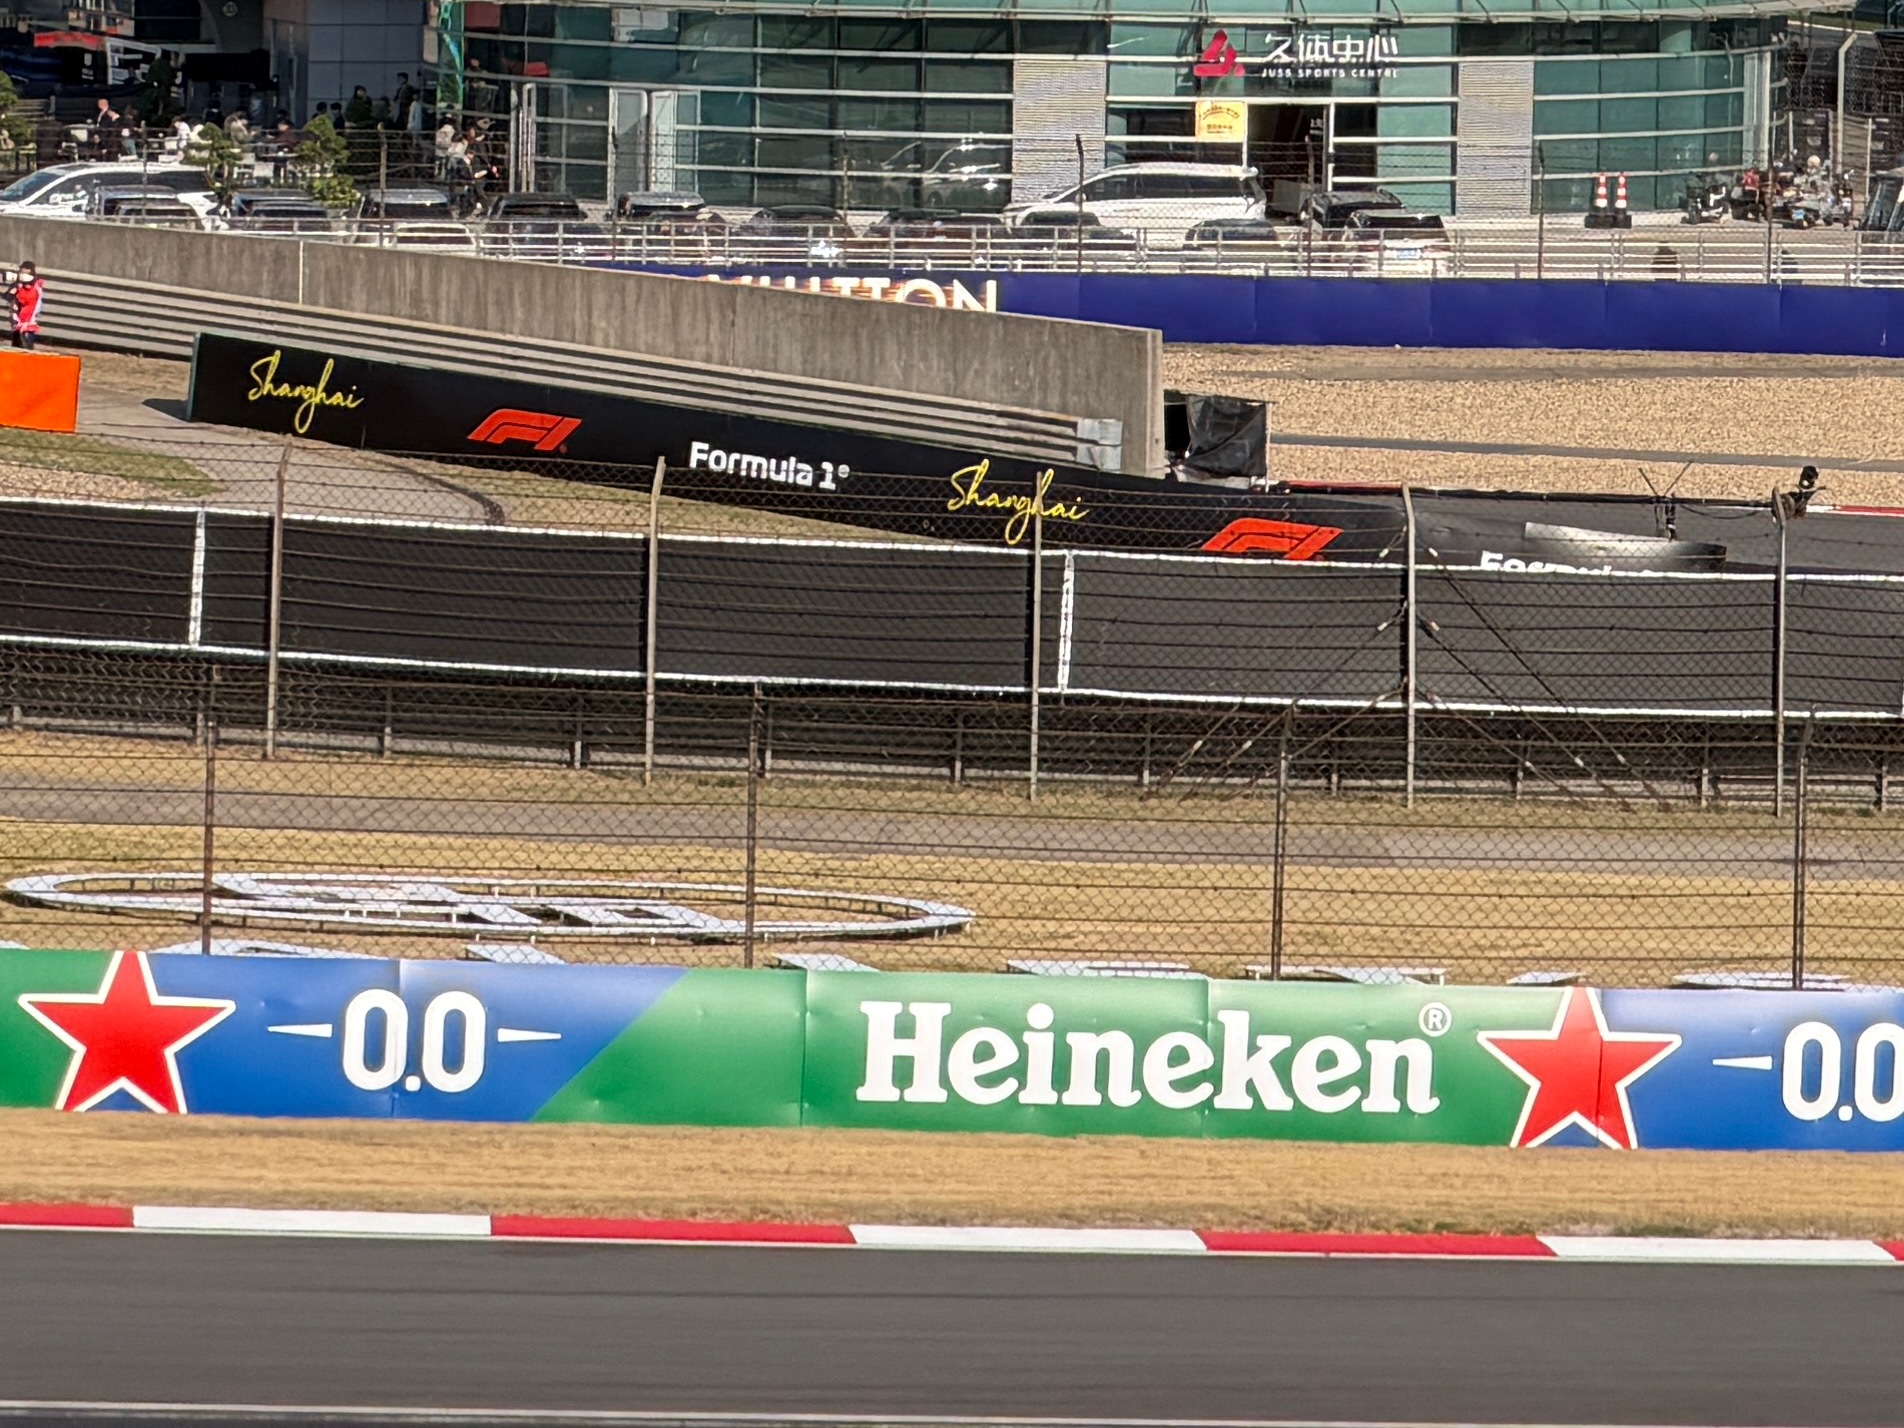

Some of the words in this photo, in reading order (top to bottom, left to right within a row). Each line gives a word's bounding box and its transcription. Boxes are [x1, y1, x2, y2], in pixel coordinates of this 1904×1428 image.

[1297, 68, 1346, 78] SPORTS
[249, 350, 364, 434] Shanghai
[689, 441, 814, 488] Formula
[947, 458, 1090, 545] Shanghai
[342, 988, 487, 1093] 0.0
